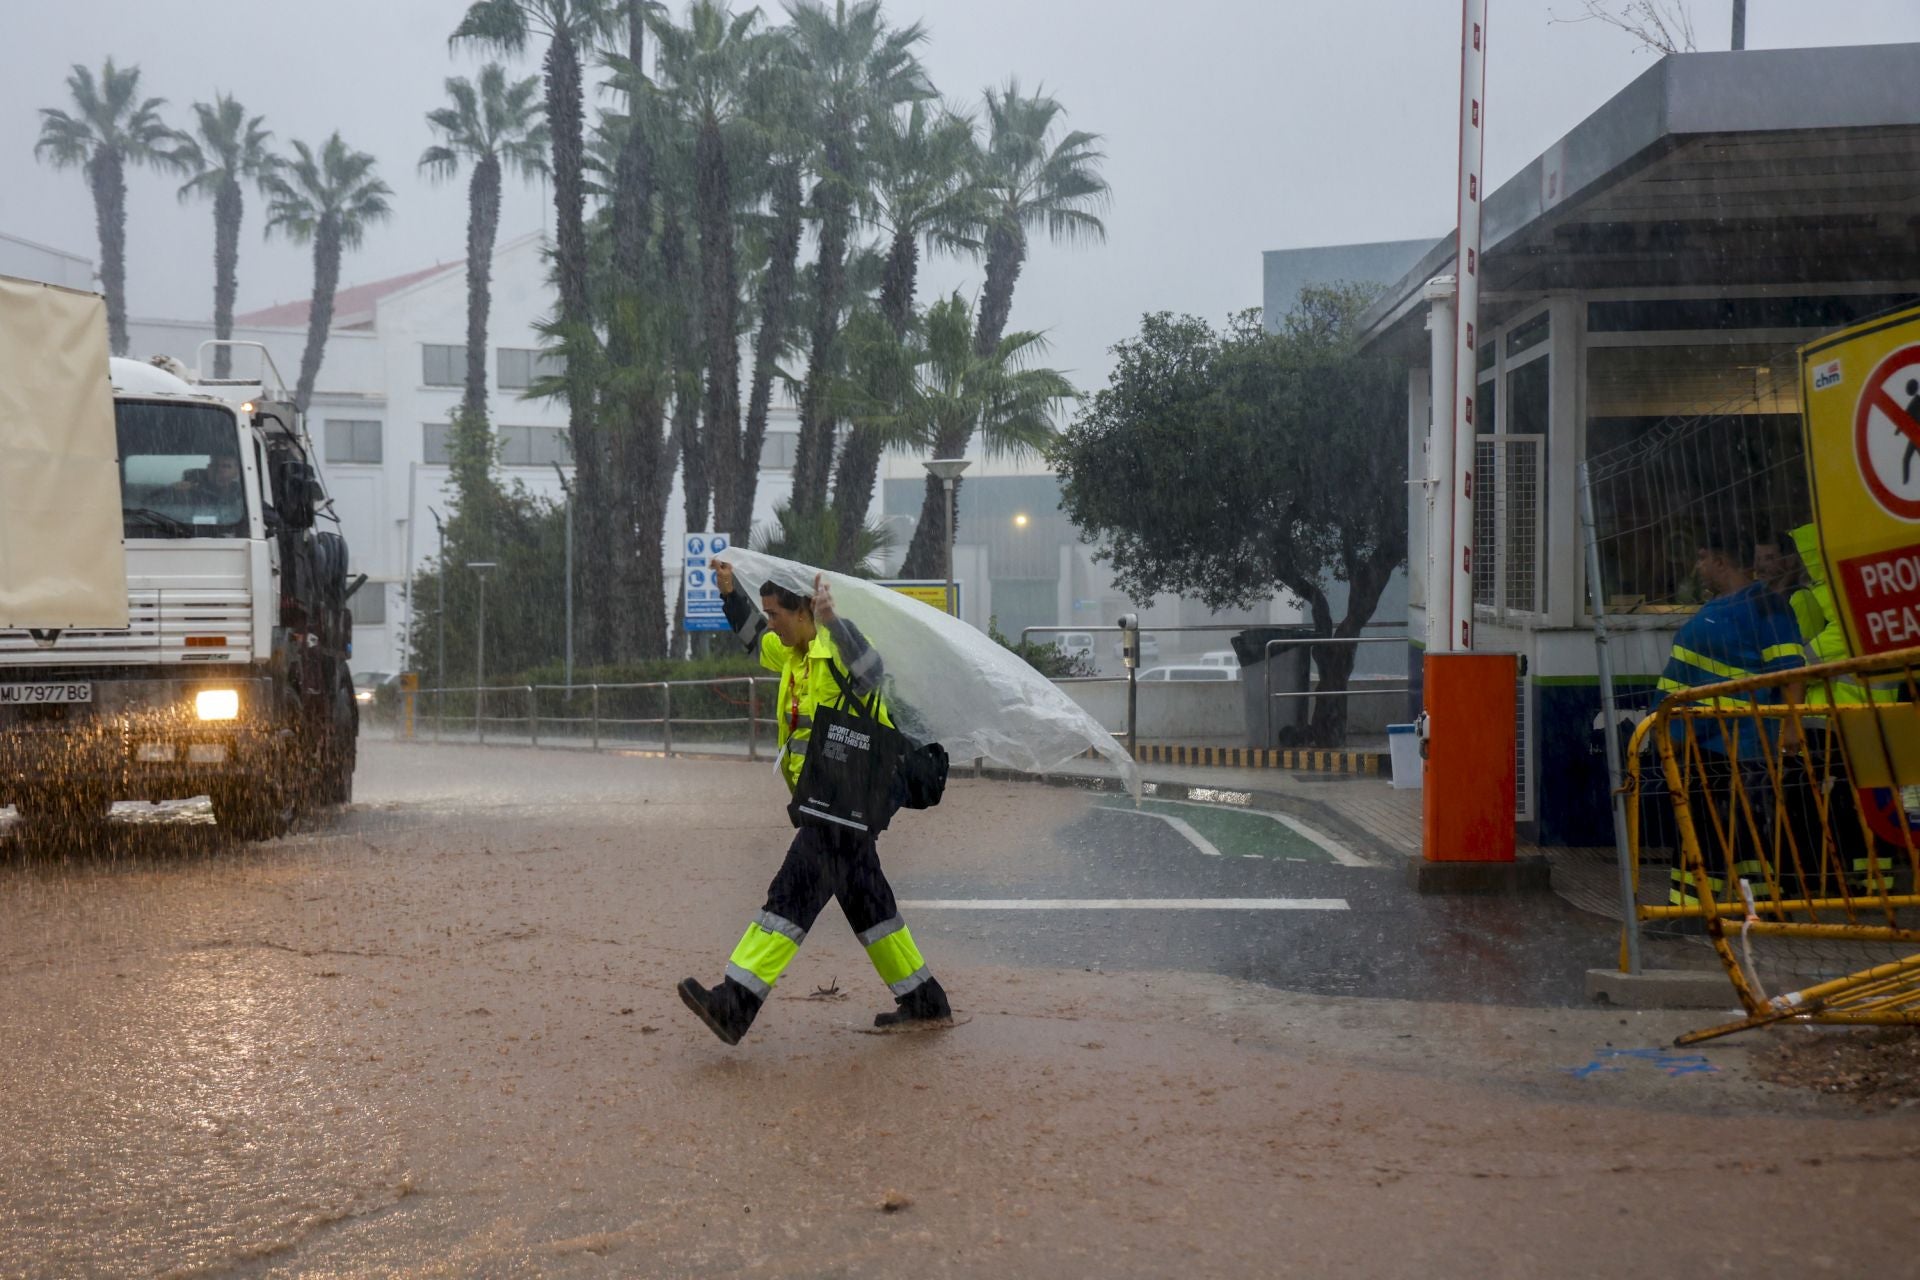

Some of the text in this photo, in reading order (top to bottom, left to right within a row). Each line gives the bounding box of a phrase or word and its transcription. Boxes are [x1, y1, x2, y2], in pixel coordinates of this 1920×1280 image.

[1815, 371, 1840, 388] chm
[1, 685, 89, 702] MU 7977 BG
[827, 732, 845, 742] WITH
[844, 736, 858, 747] THIS
[829, 723, 870, 743] SPORT BEGINS
